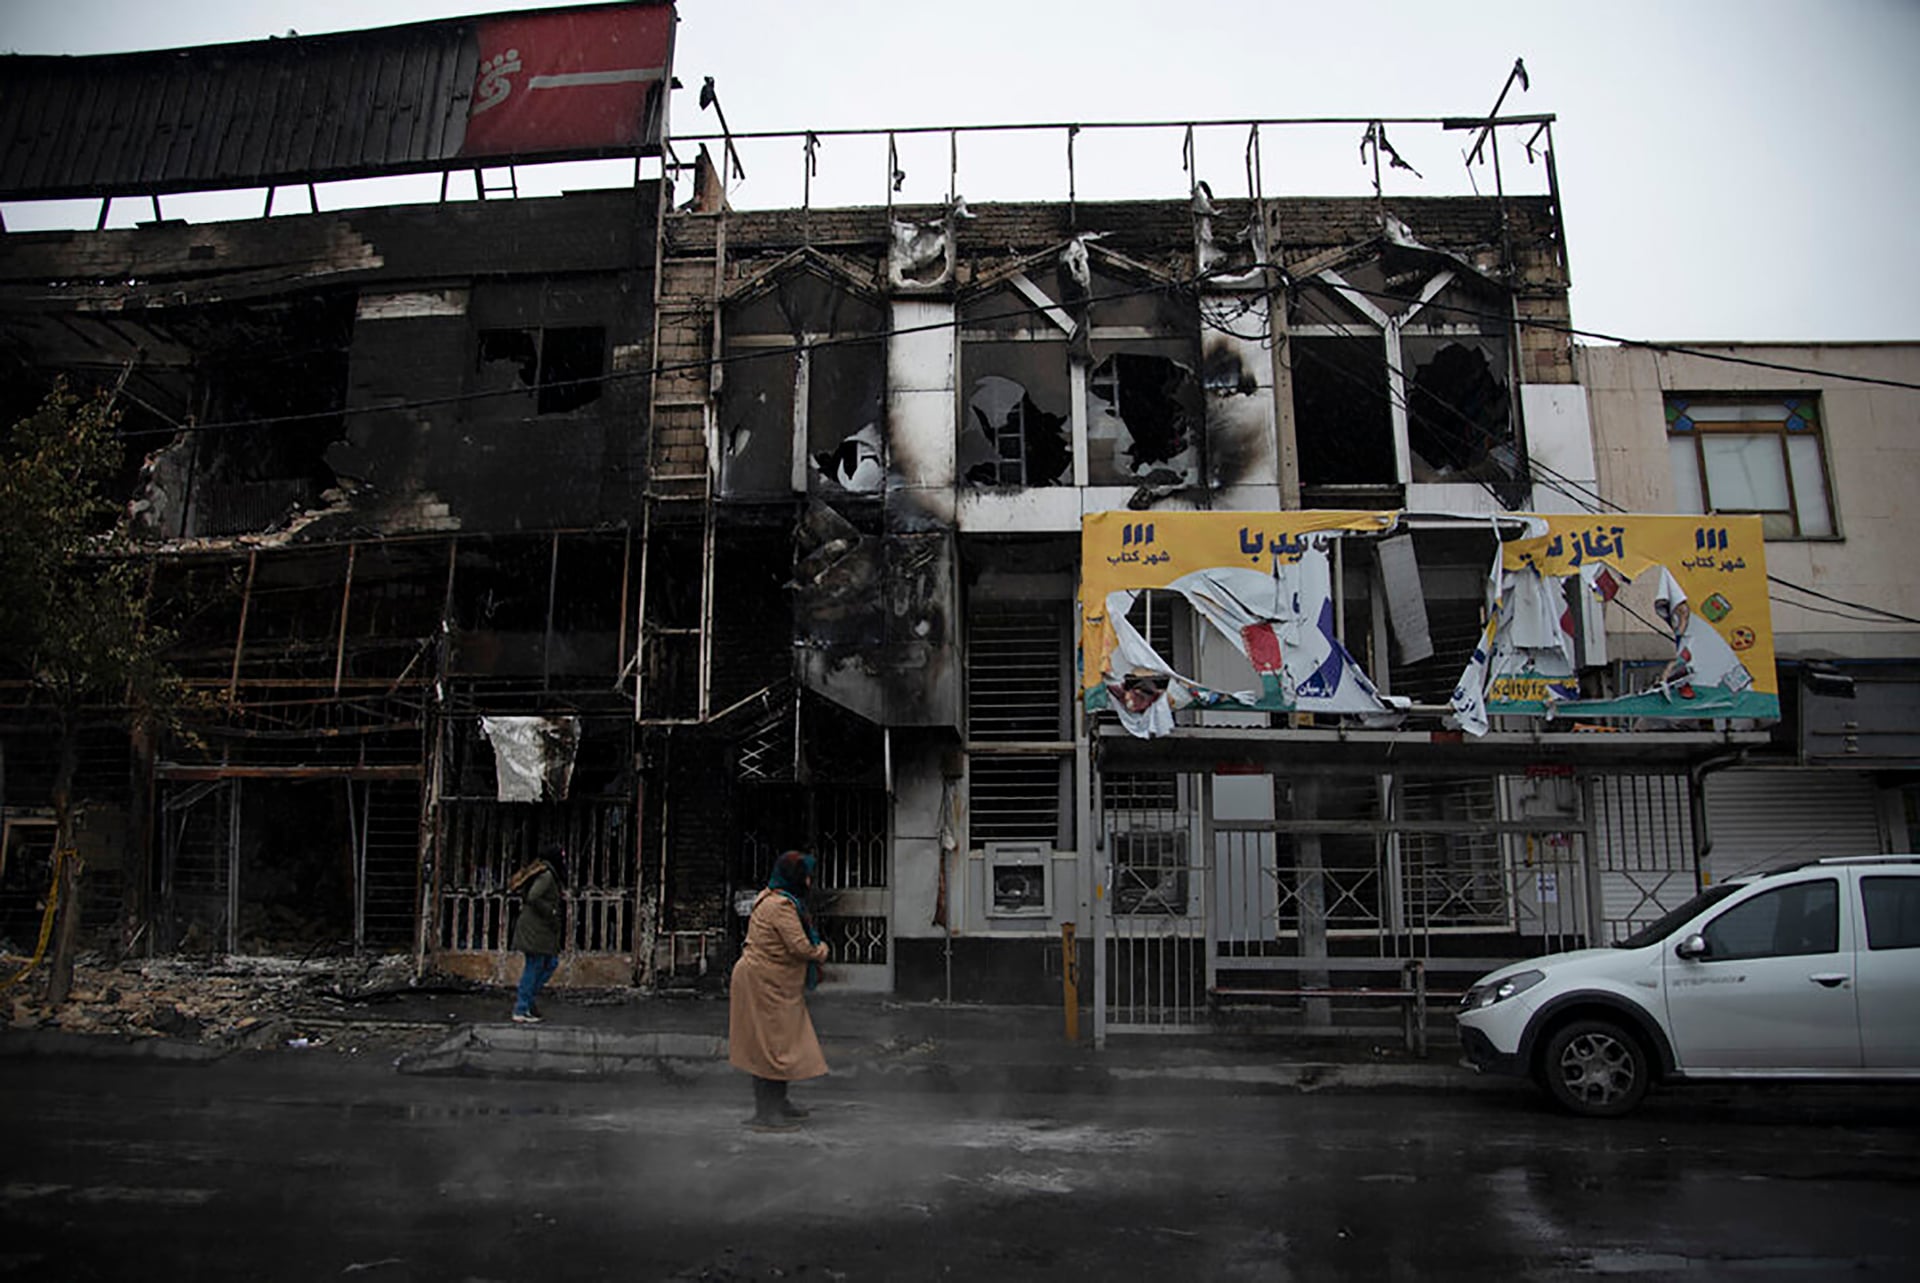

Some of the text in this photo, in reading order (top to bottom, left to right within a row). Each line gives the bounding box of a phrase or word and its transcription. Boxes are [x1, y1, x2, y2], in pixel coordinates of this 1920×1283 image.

[1107, 550, 1170, 566] شهر کتاب
[1239, 527, 1264, 563] با
[1568, 525, 1624, 567] آغاز
[1682, 556, 1746, 573] شهر کتاب
